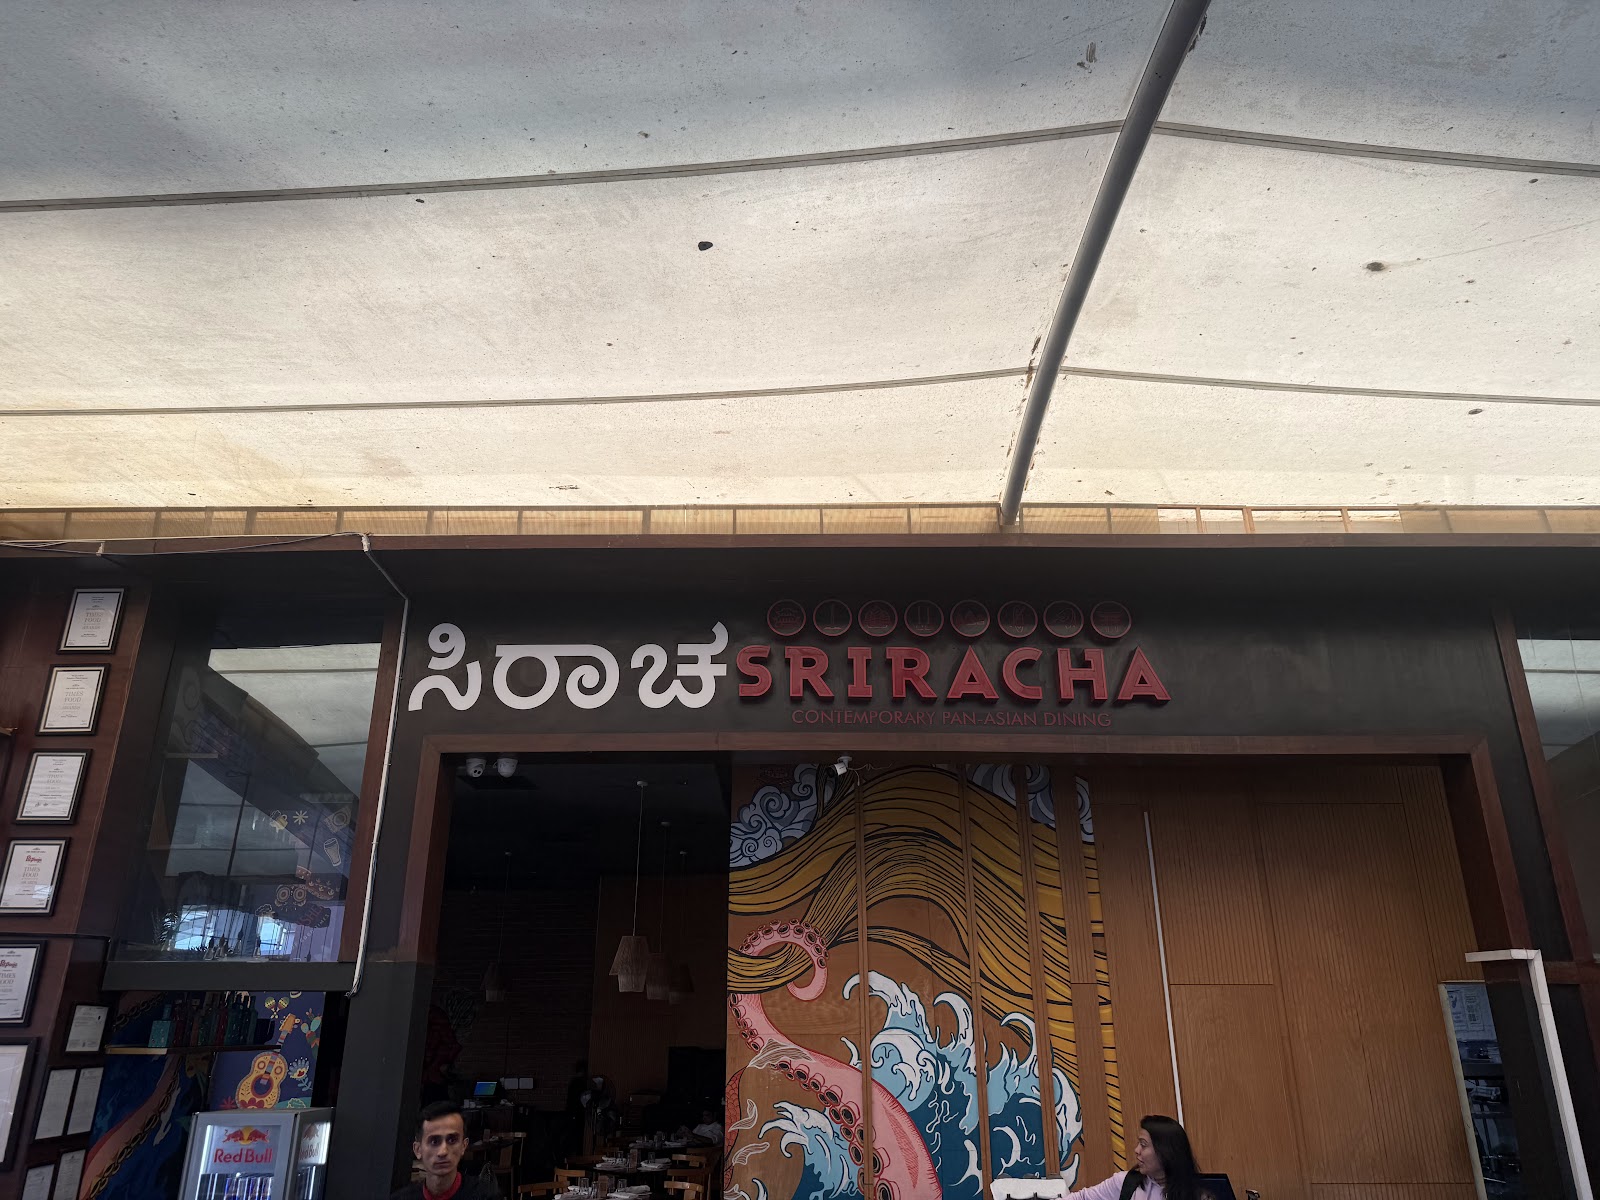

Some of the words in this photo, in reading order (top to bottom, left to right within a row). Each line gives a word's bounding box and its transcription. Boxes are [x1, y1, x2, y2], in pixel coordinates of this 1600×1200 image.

[408, 621, 728, 711] ಸಿರಾಚ
[736, 645, 1171, 702] SRIRACHA
[791, 709, 936, 725] CONTEMPORARY
[942, 711, 1038, 726] PAN-ASIAN
[1043, 711, 1112, 727] DINING
[213, 1148, 243, 1163] Red
[244, 1148, 273, 1163] Bull
